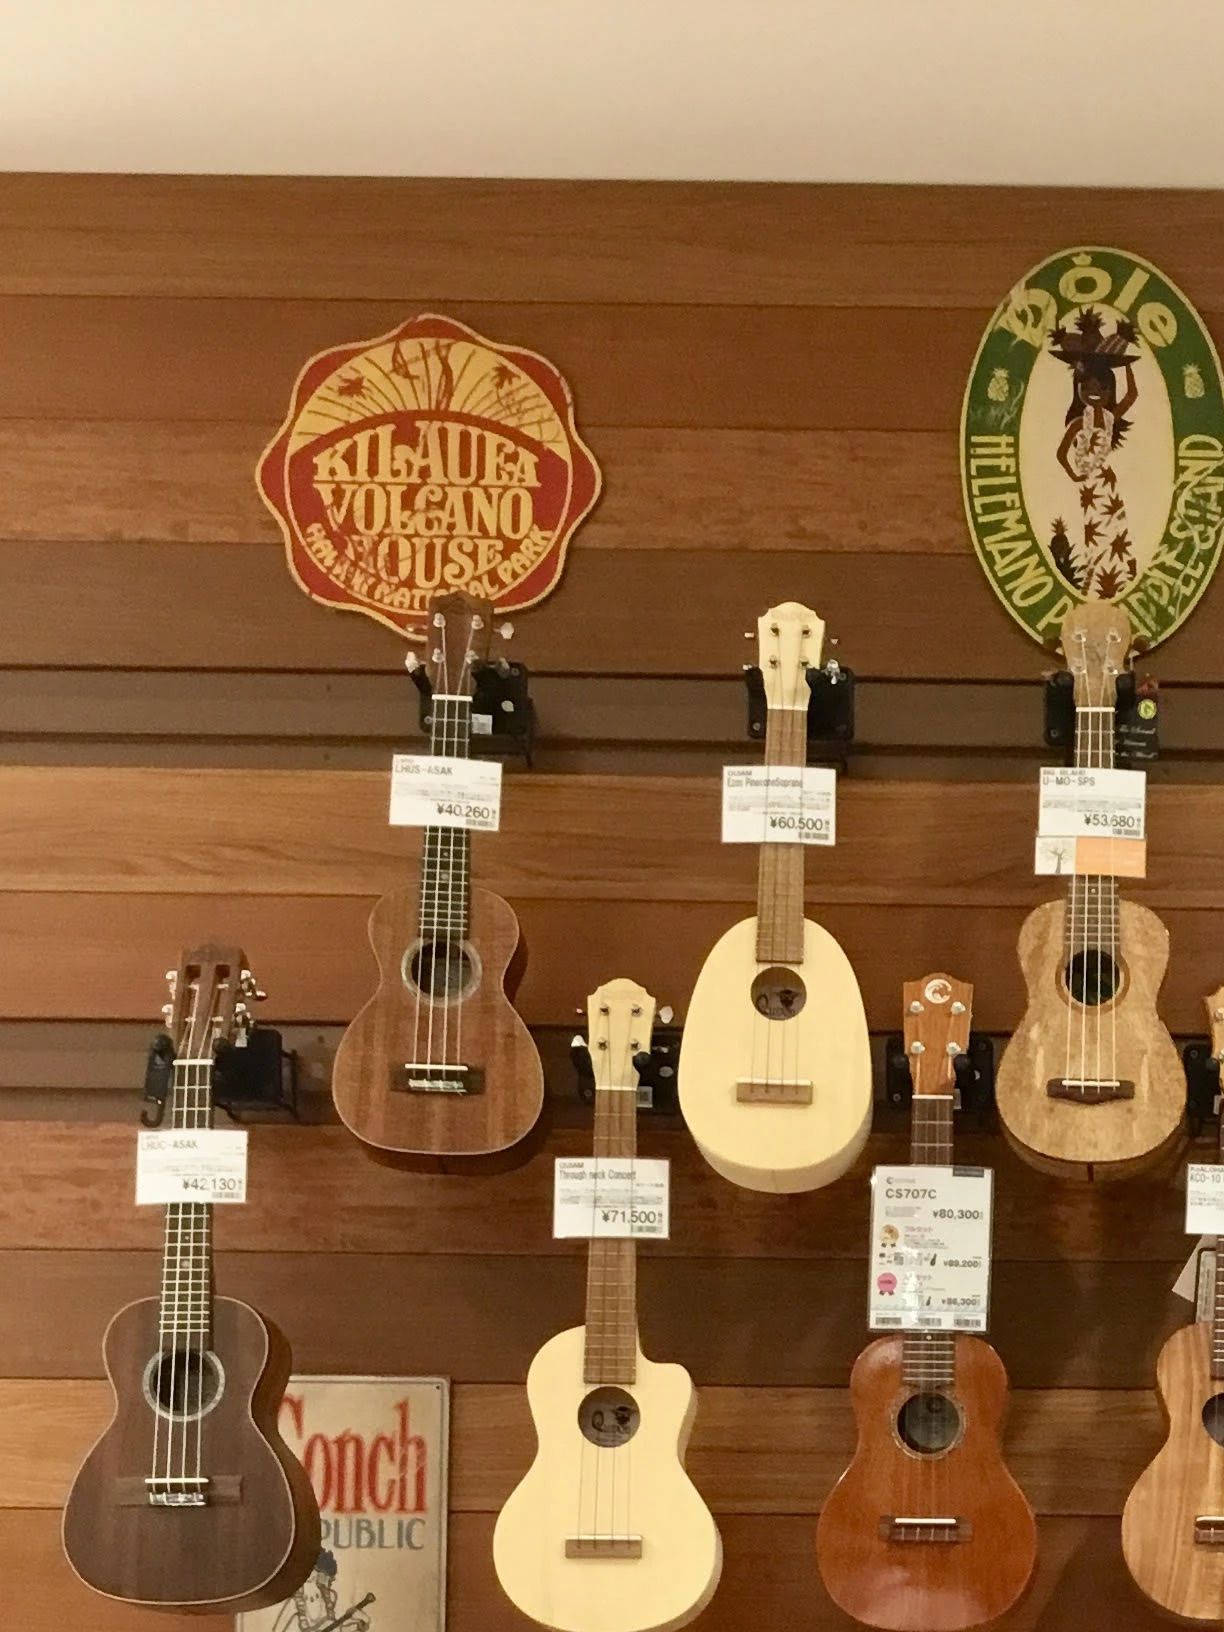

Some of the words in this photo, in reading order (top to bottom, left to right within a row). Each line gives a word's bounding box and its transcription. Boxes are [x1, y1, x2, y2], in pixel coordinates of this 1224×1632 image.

[313, 421, 541, 487] KILAUEA
[313, 483, 534, 539] VOLCANO
[969, 434, 1055, 608] HELEMANO
[344, 535, 504, 588] HOUSE
[496, 523, 553, 585] PARK
[770, 816, 823, 829] ¥60,500
[182, 1178, 236, 1190] ¥42,130
[885, 1188, 937, 1199] CS707C
[602, 1211, 656, 1223] ¥71,500
[933, 1209, 979, 1219] ¥80,300
